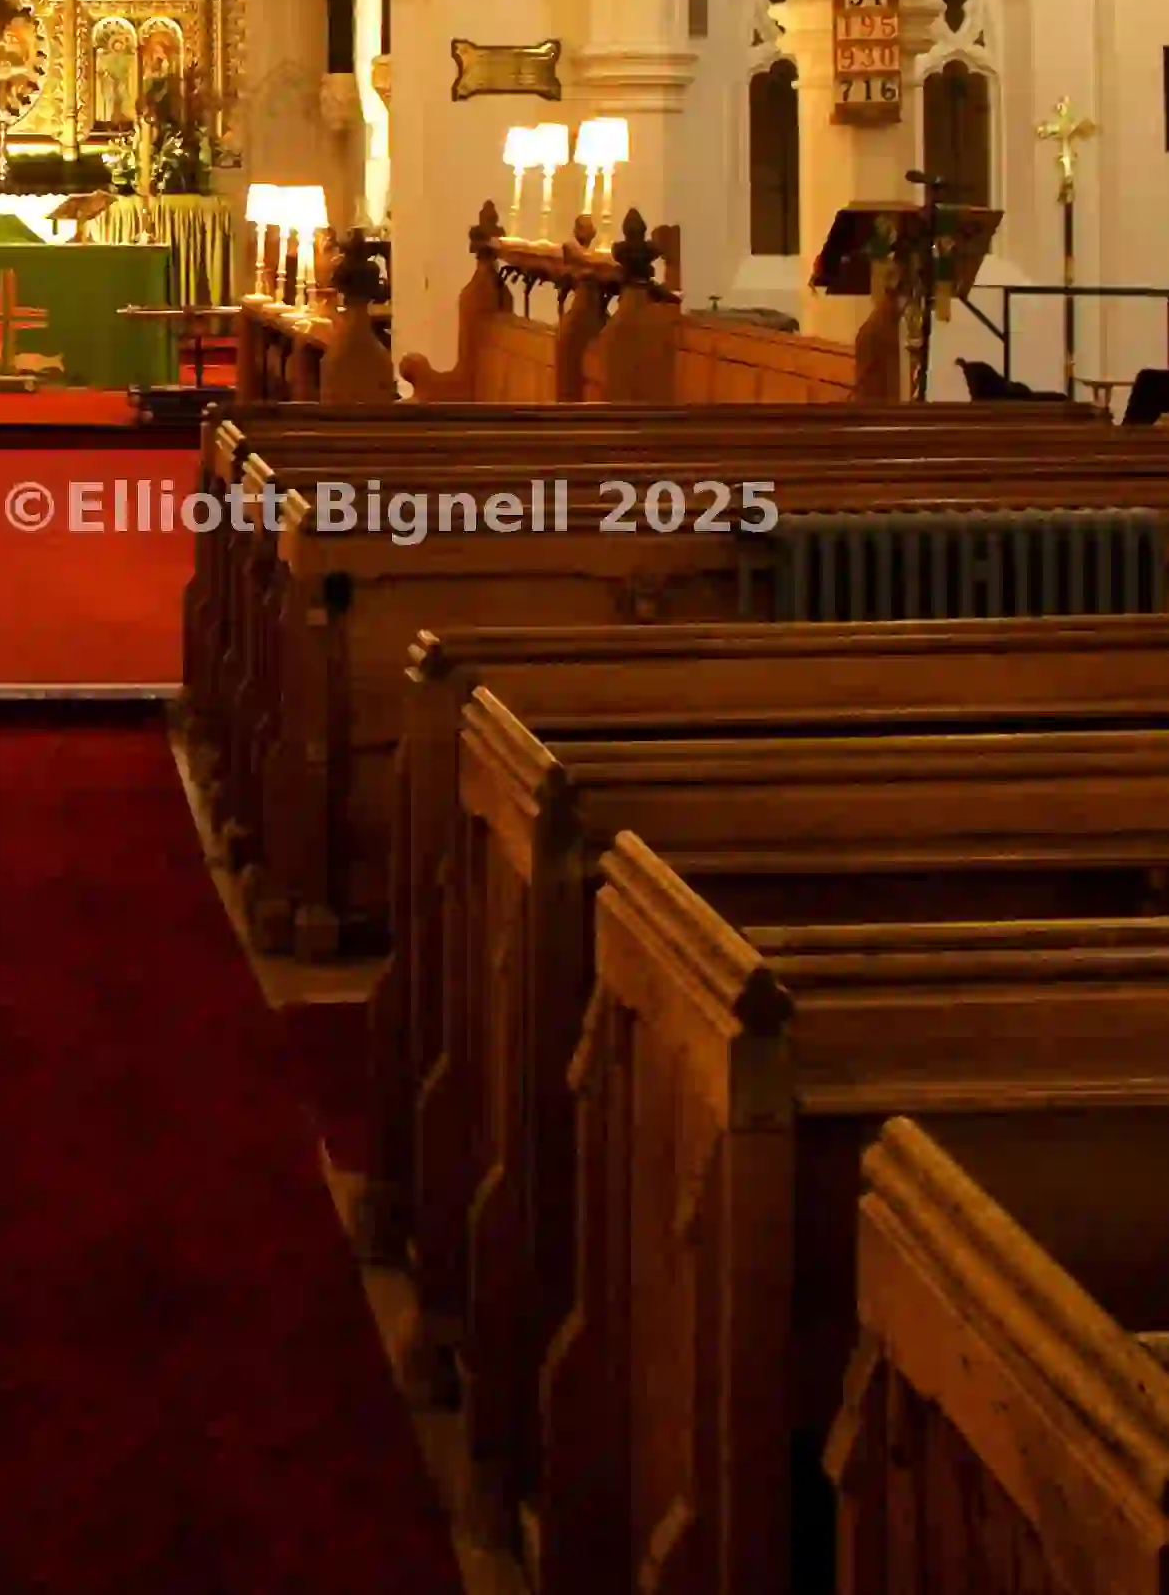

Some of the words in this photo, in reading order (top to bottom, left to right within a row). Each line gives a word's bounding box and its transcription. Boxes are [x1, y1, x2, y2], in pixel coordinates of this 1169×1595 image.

[841, 15, 896, 37] 195
[840, 46, 894, 69] 930
[840, 79, 896, 101] 716
